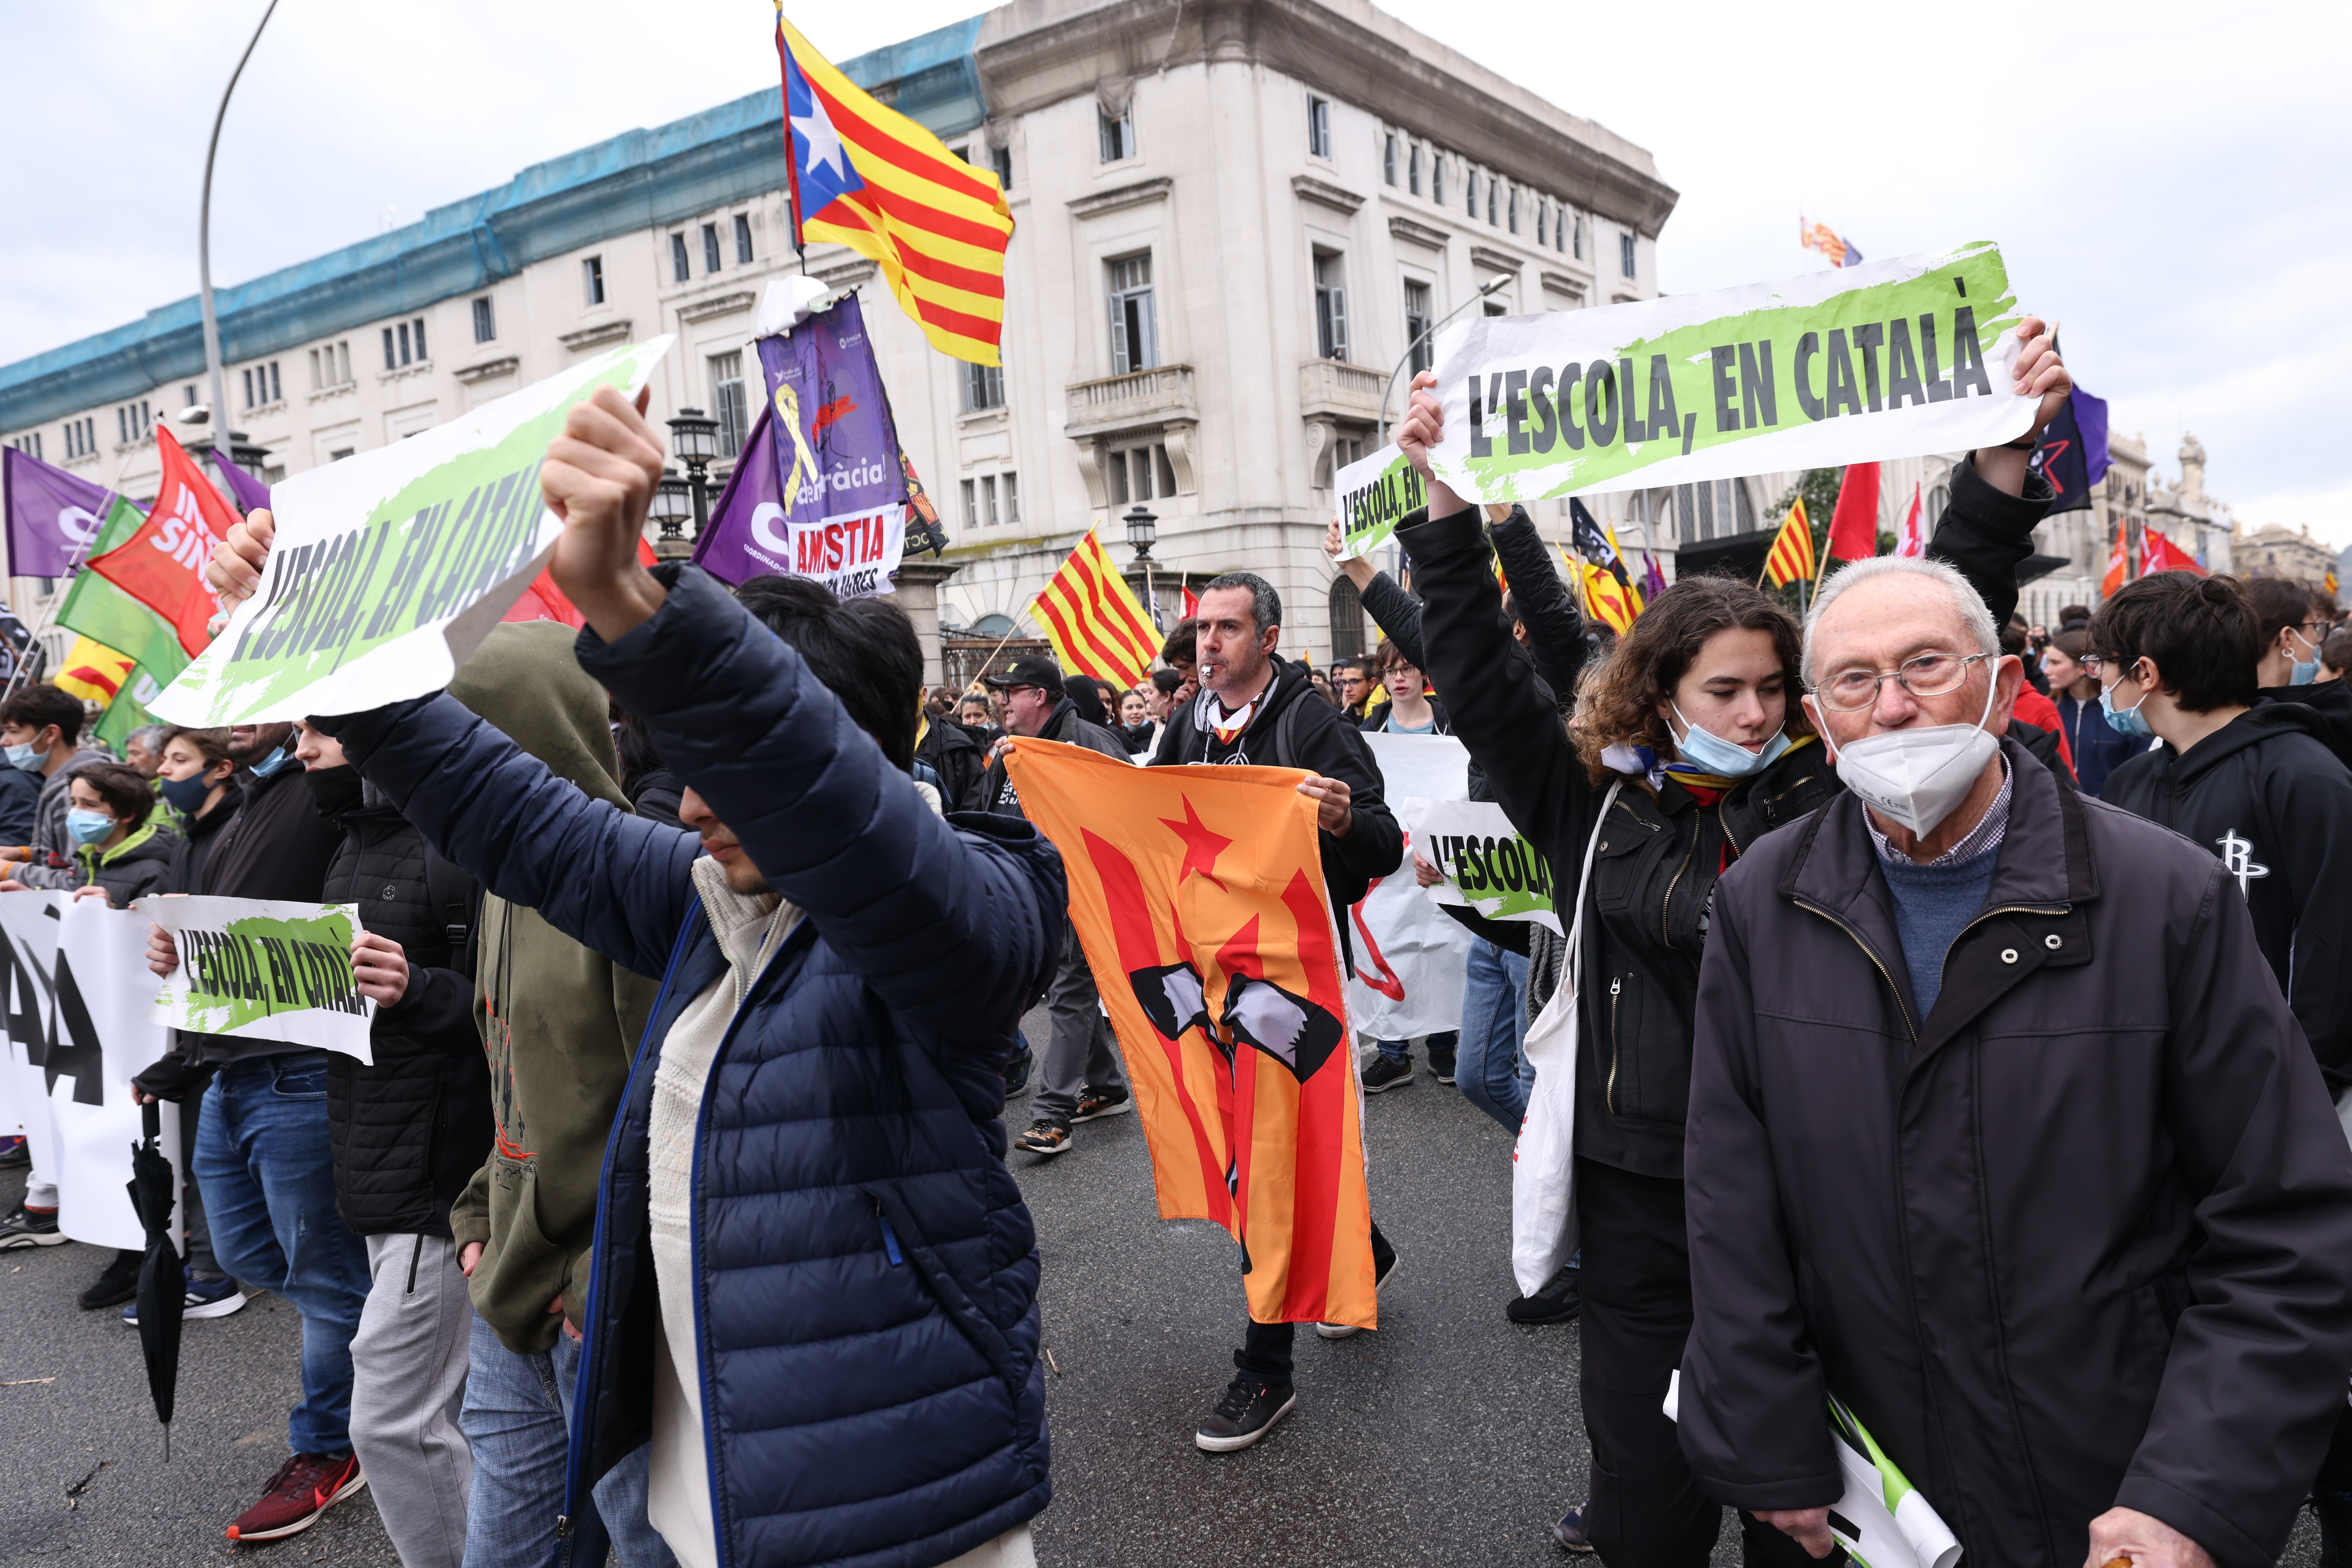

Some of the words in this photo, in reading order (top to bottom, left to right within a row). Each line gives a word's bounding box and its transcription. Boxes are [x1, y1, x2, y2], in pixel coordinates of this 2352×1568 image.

[1468, 354, 1697, 457] L'ESCOLA,
[1711, 339, 1778, 432] EN
[1794, 277, 1993, 422] CATALÀ
[1342, 473, 1402, 536] L'ESCOLA,
[1402, 464, 1421, 511] EN
[230, 520, 392, 675] L'ESCOLA,
[362, 498, 453, 640] EN
[178, 929, 271, 1017] L'ESCOLA,
[259, 936, 300, 1005] EN
